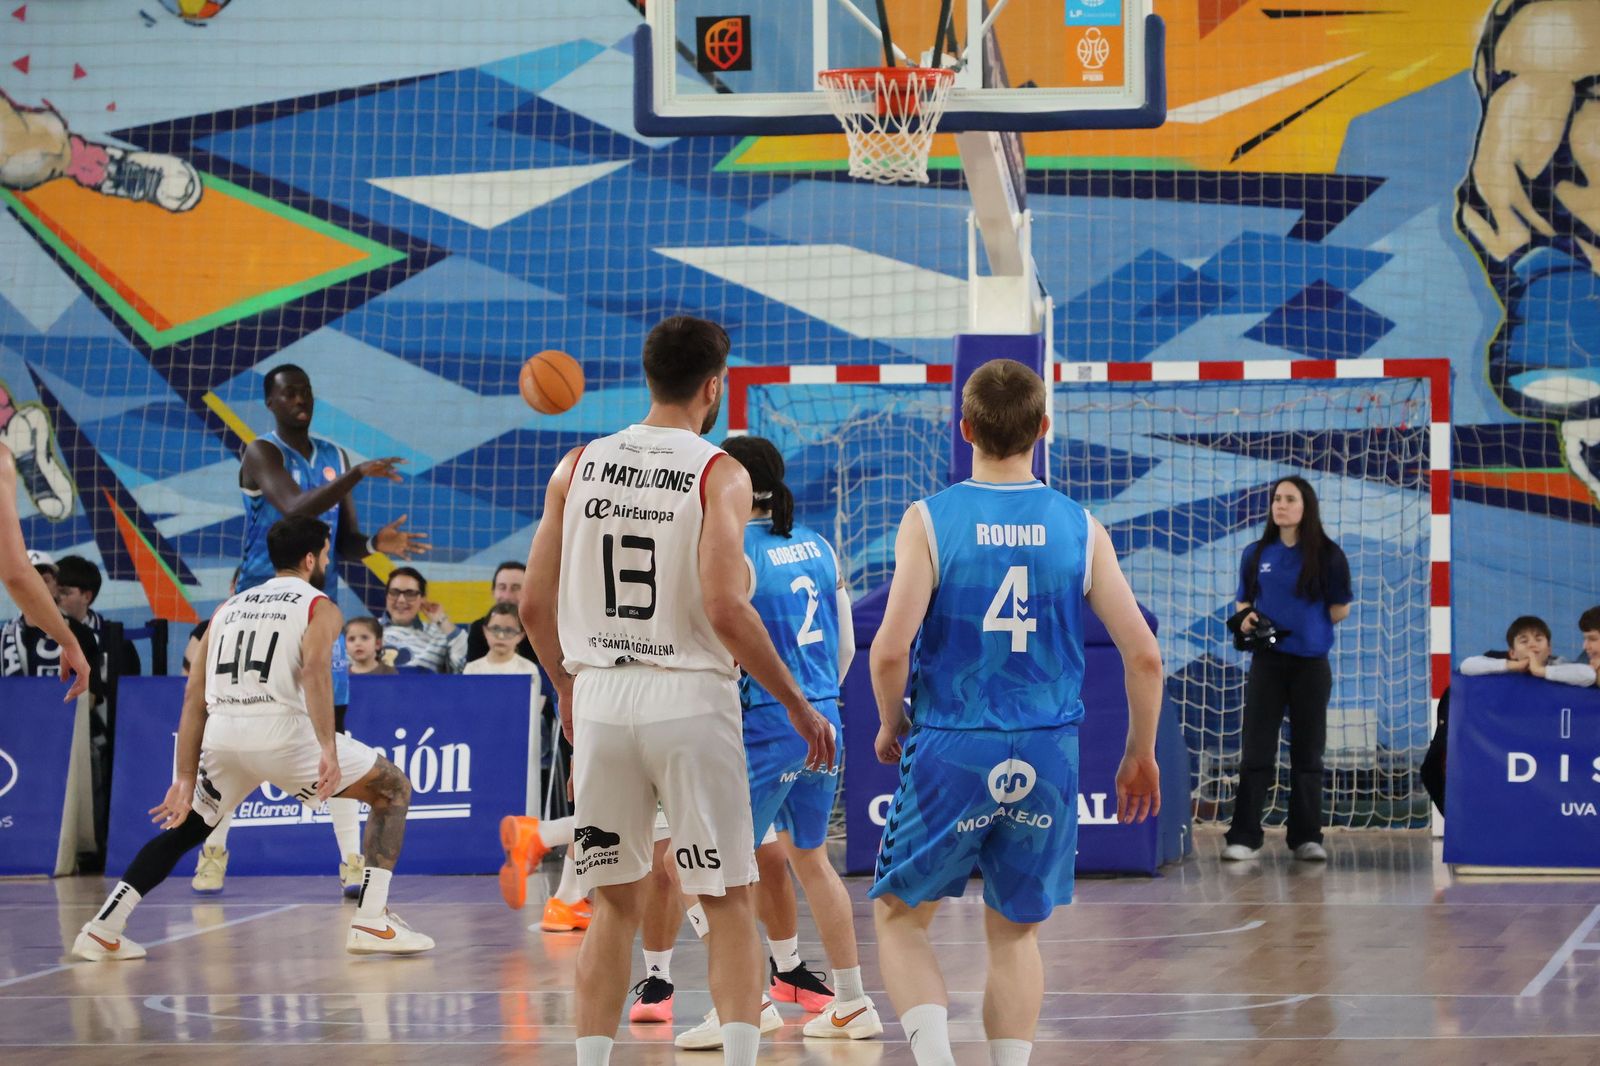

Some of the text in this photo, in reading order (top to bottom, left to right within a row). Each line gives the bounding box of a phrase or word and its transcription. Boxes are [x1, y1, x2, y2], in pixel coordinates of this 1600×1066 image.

[600, 462, 695, 493] MATULIONIS
[612, 504, 675, 524] AirEuropa
[976, 523, 1046, 548] ROUND
[767, 541, 822, 567] ROBERTS
[603, 534, 656, 621] 13
[790, 575, 823, 647] 2
[982, 565, 1037, 653] 4
[215, 630, 279, 684] 44
[240, 802, 253, 818] El
[254, 801, 299, 817] Correo
[1561, 802, 1597, 816] UVA
[592, 850, 619, 858] COCHE
[676, 844, 721, 870] als
